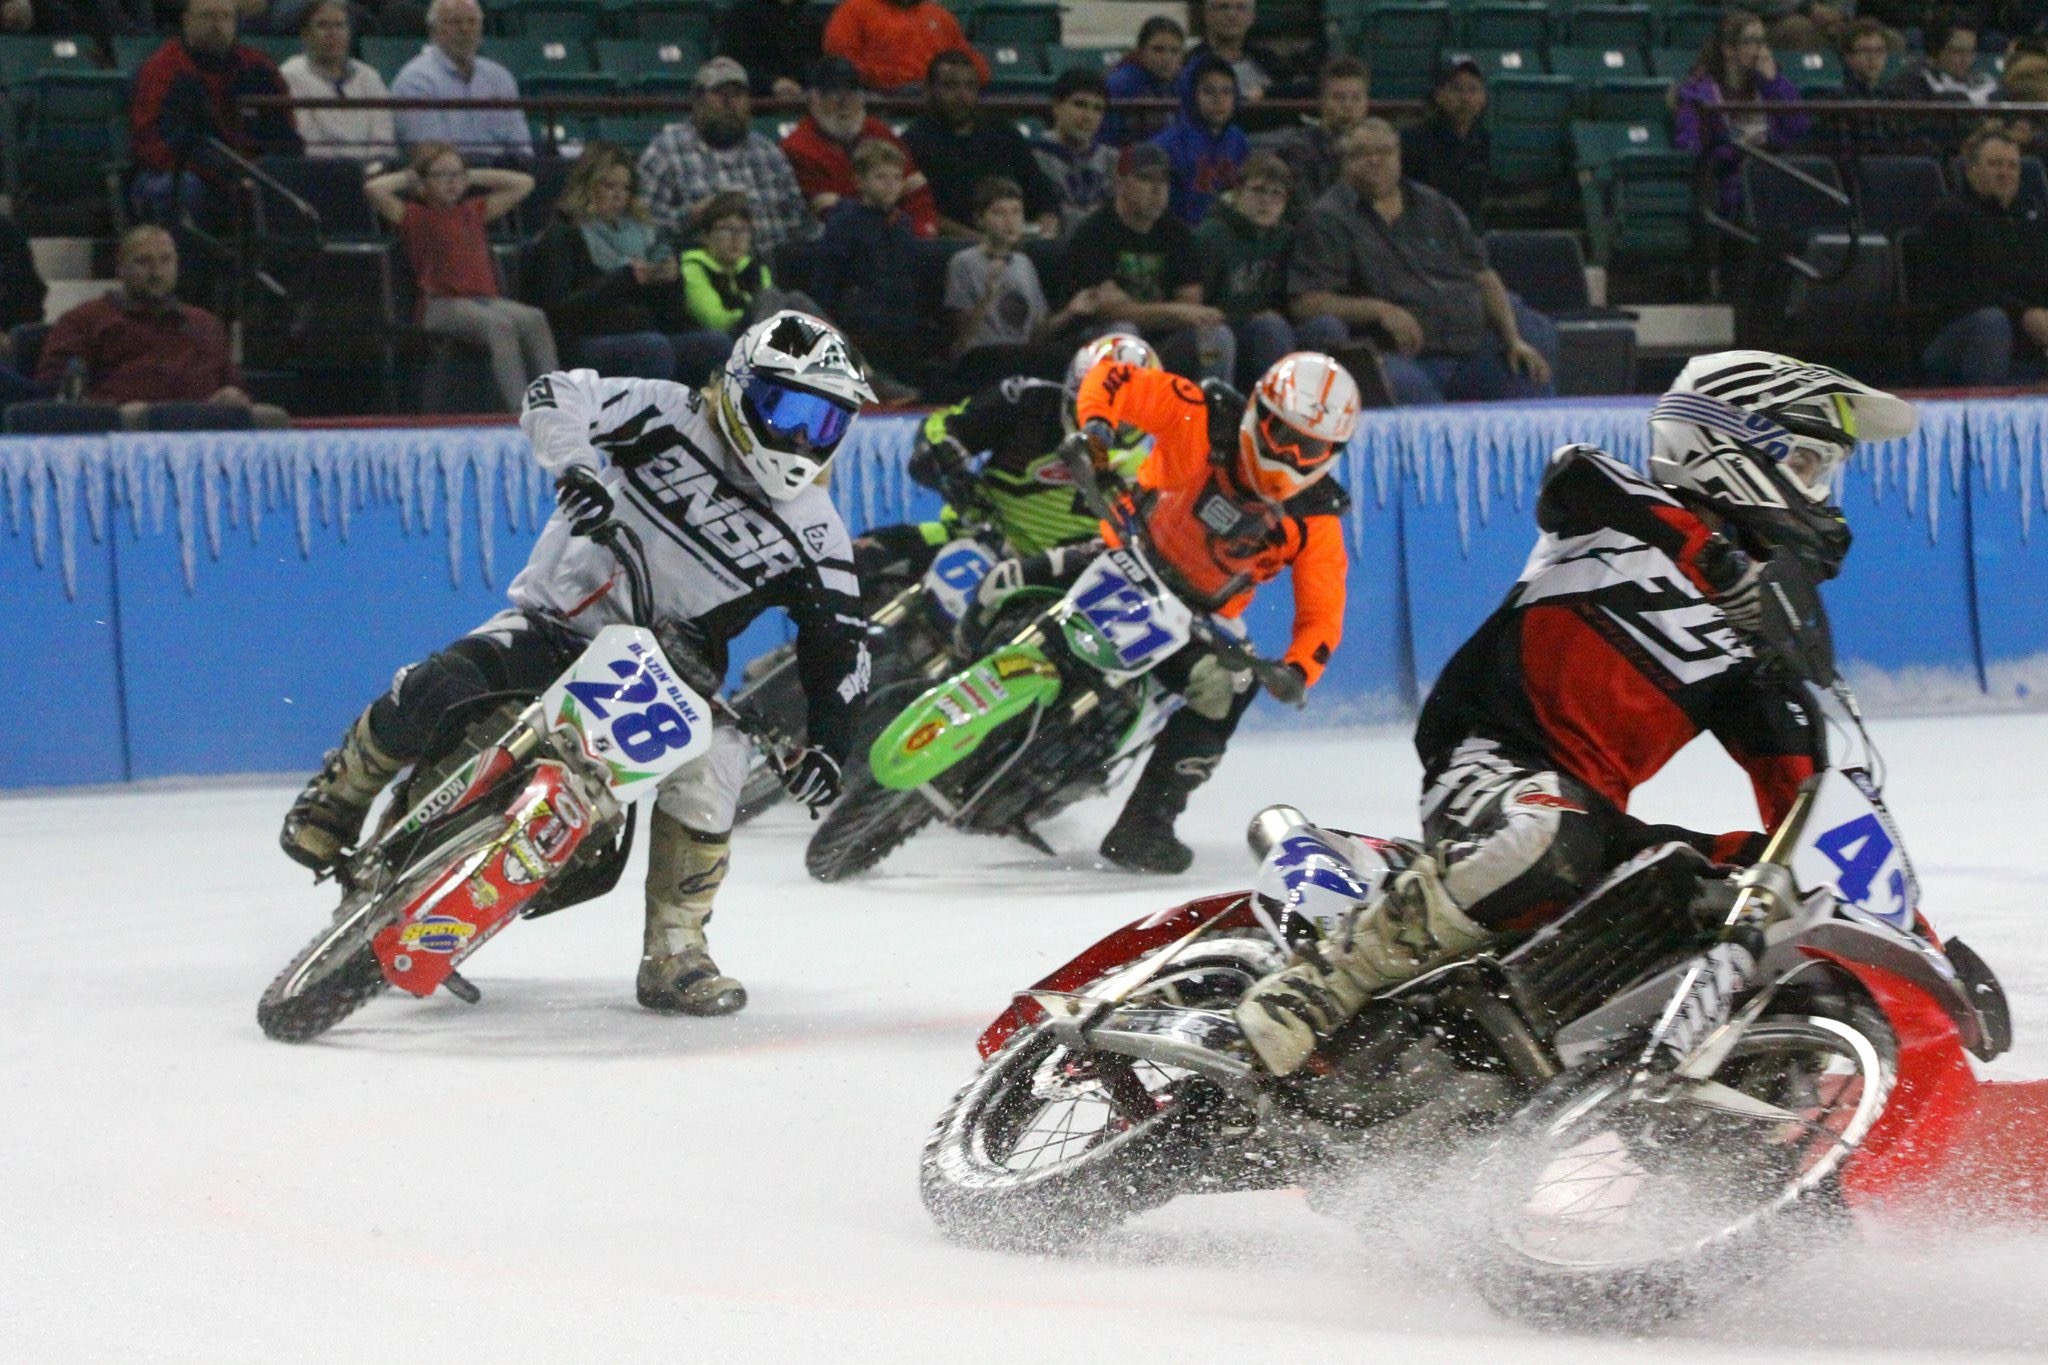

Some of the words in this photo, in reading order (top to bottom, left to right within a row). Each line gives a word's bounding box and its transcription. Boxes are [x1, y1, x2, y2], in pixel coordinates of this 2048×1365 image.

[1074, 567, 1174, 663] 121
[564, 659, 692, 763] 28
[667, 686, 700, 723] BLAKE
[416, 777, 466, 824] MOTO
